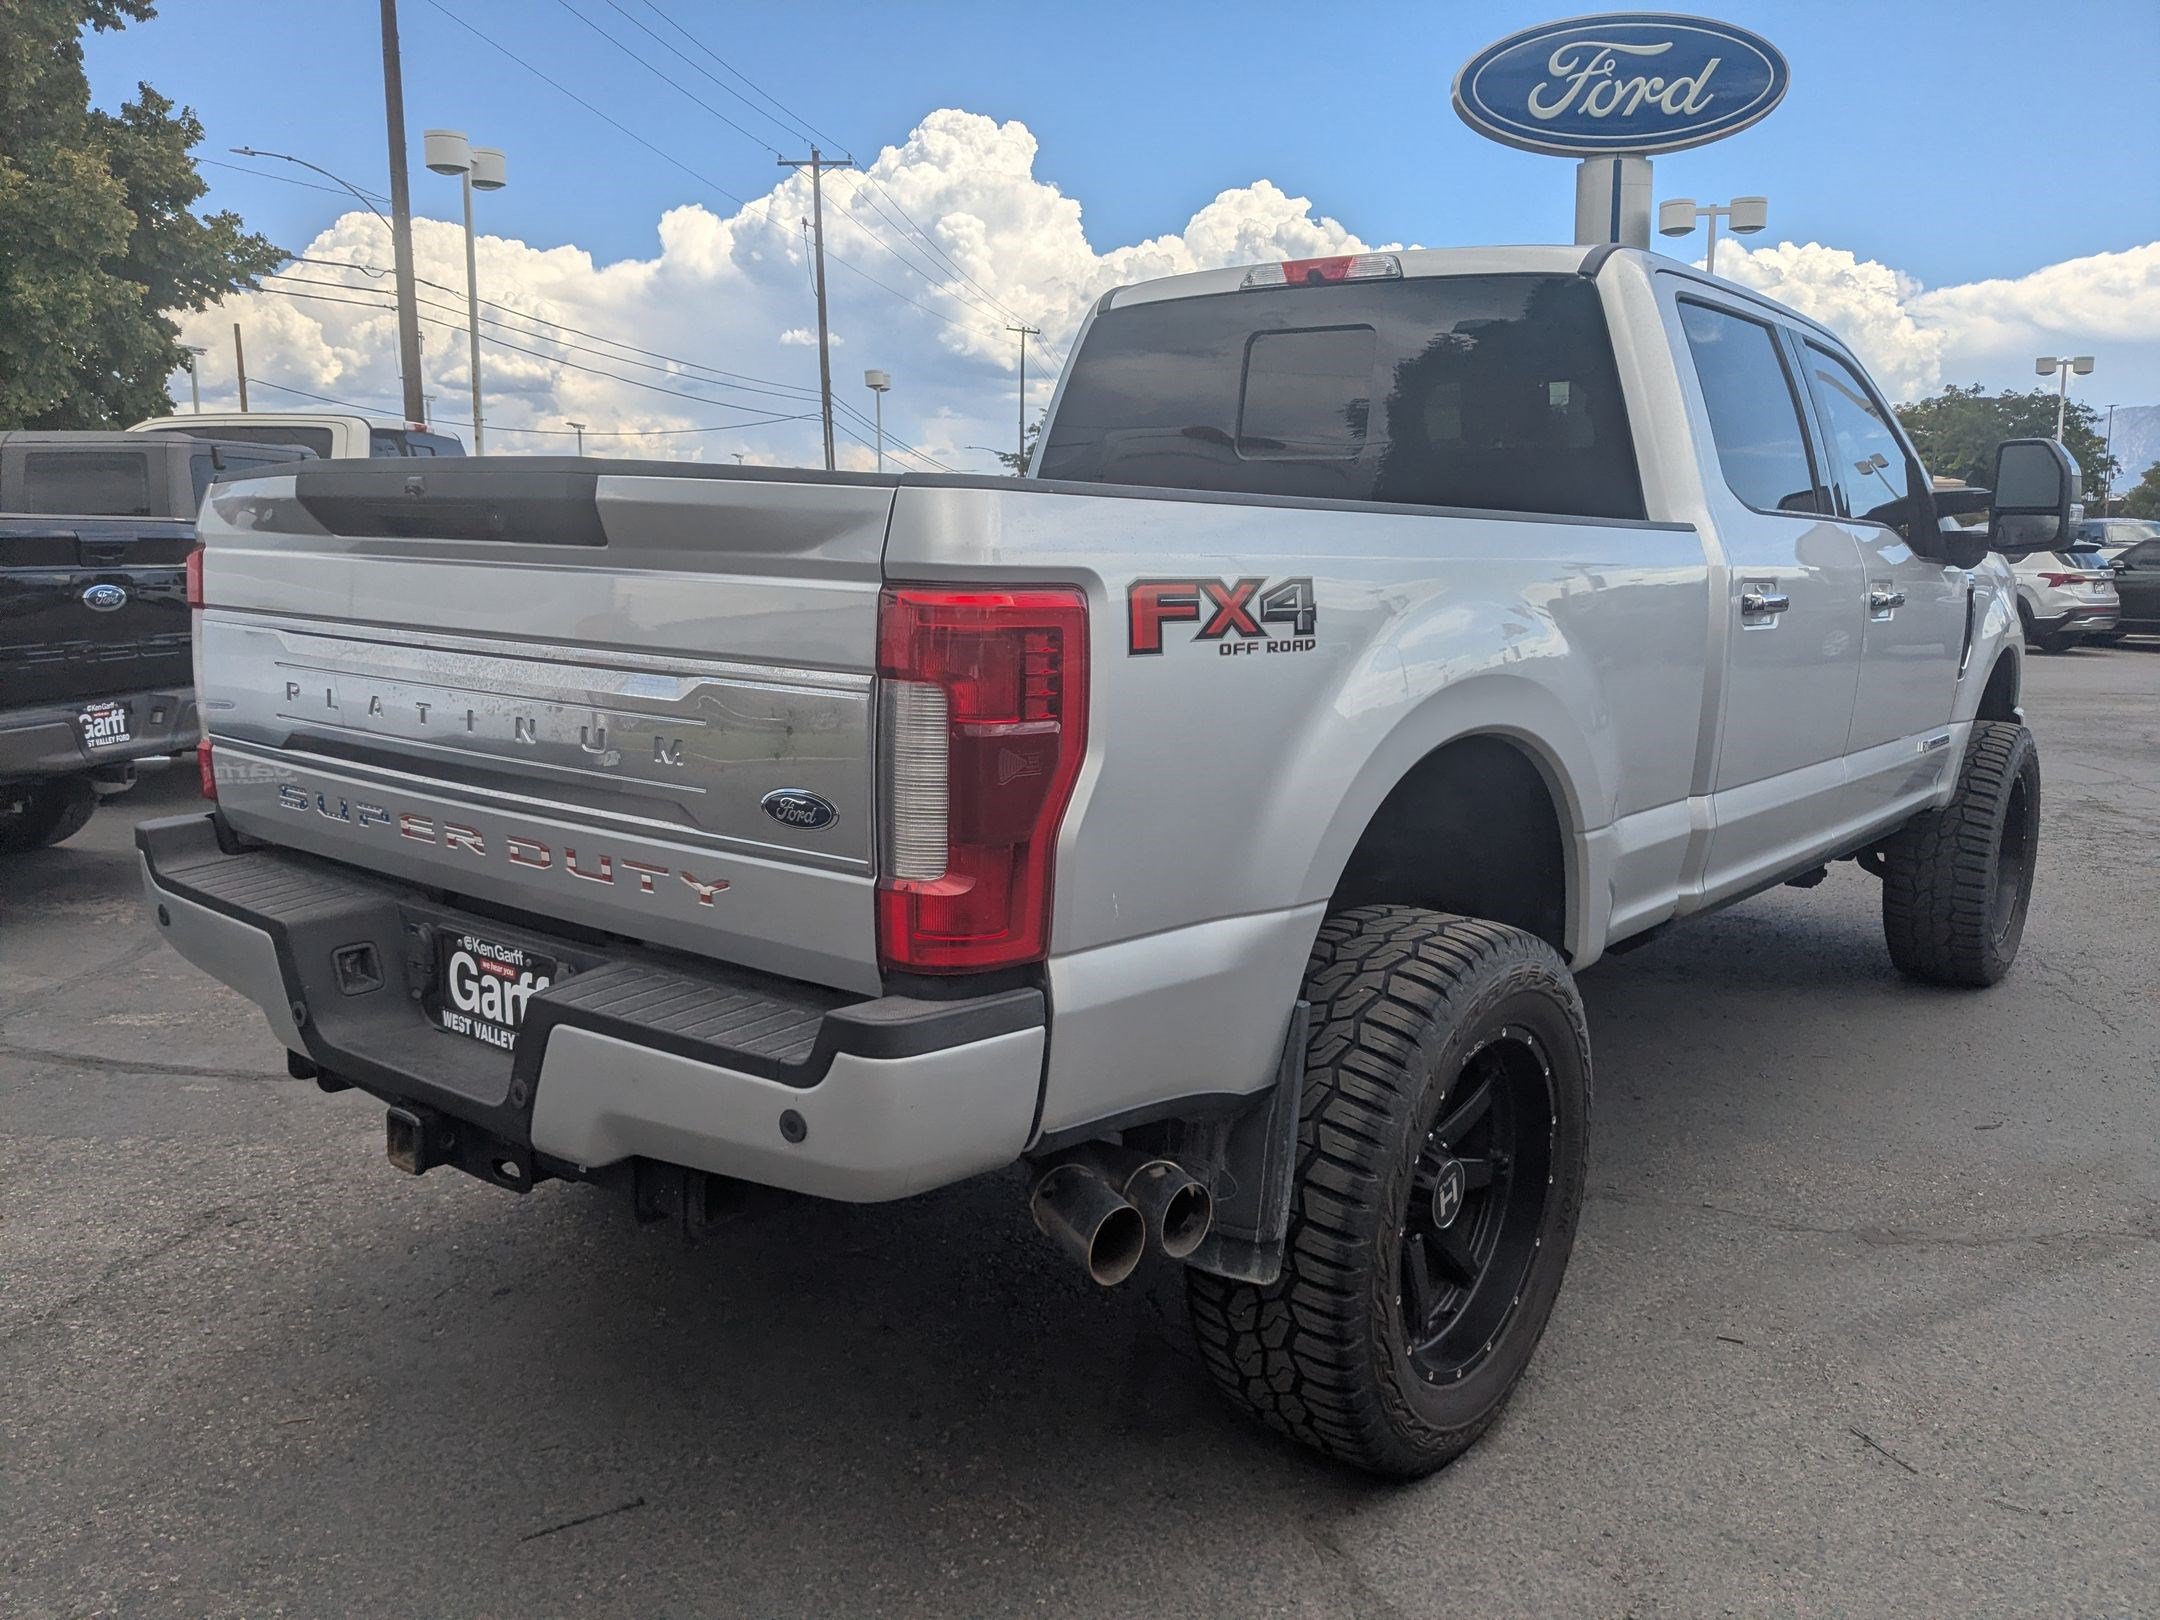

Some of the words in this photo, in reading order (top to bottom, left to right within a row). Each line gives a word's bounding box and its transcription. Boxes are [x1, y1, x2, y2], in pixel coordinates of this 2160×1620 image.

[1528, 41, 1722, 119] Ford
[95, 590, 119, 605] Ford
[1126, 576, 1317, 658] FX4
[1219, 641, 1259, 656] OFF
[1266, 639, 1316, 654] ROAD
[79, 709, 125, 740] Garff
[95, 736, 115, 746] VALLEY
[116, 733, 130, 742] FORD
[286, 681, 684, 767] PLATINUM
[776, 797, 817, 824] Ford
[279, 783, 487, 857] SUPER
[506, 834, 731, 908] DUTY
[472, 936, 495, 959] Ken
[494, 945, 524, 967] Garff
[503, 967, 515, 977] you
[443, 1009, 473, 1036] WEST
[474, 1020, 516, 1051] VALLEY
